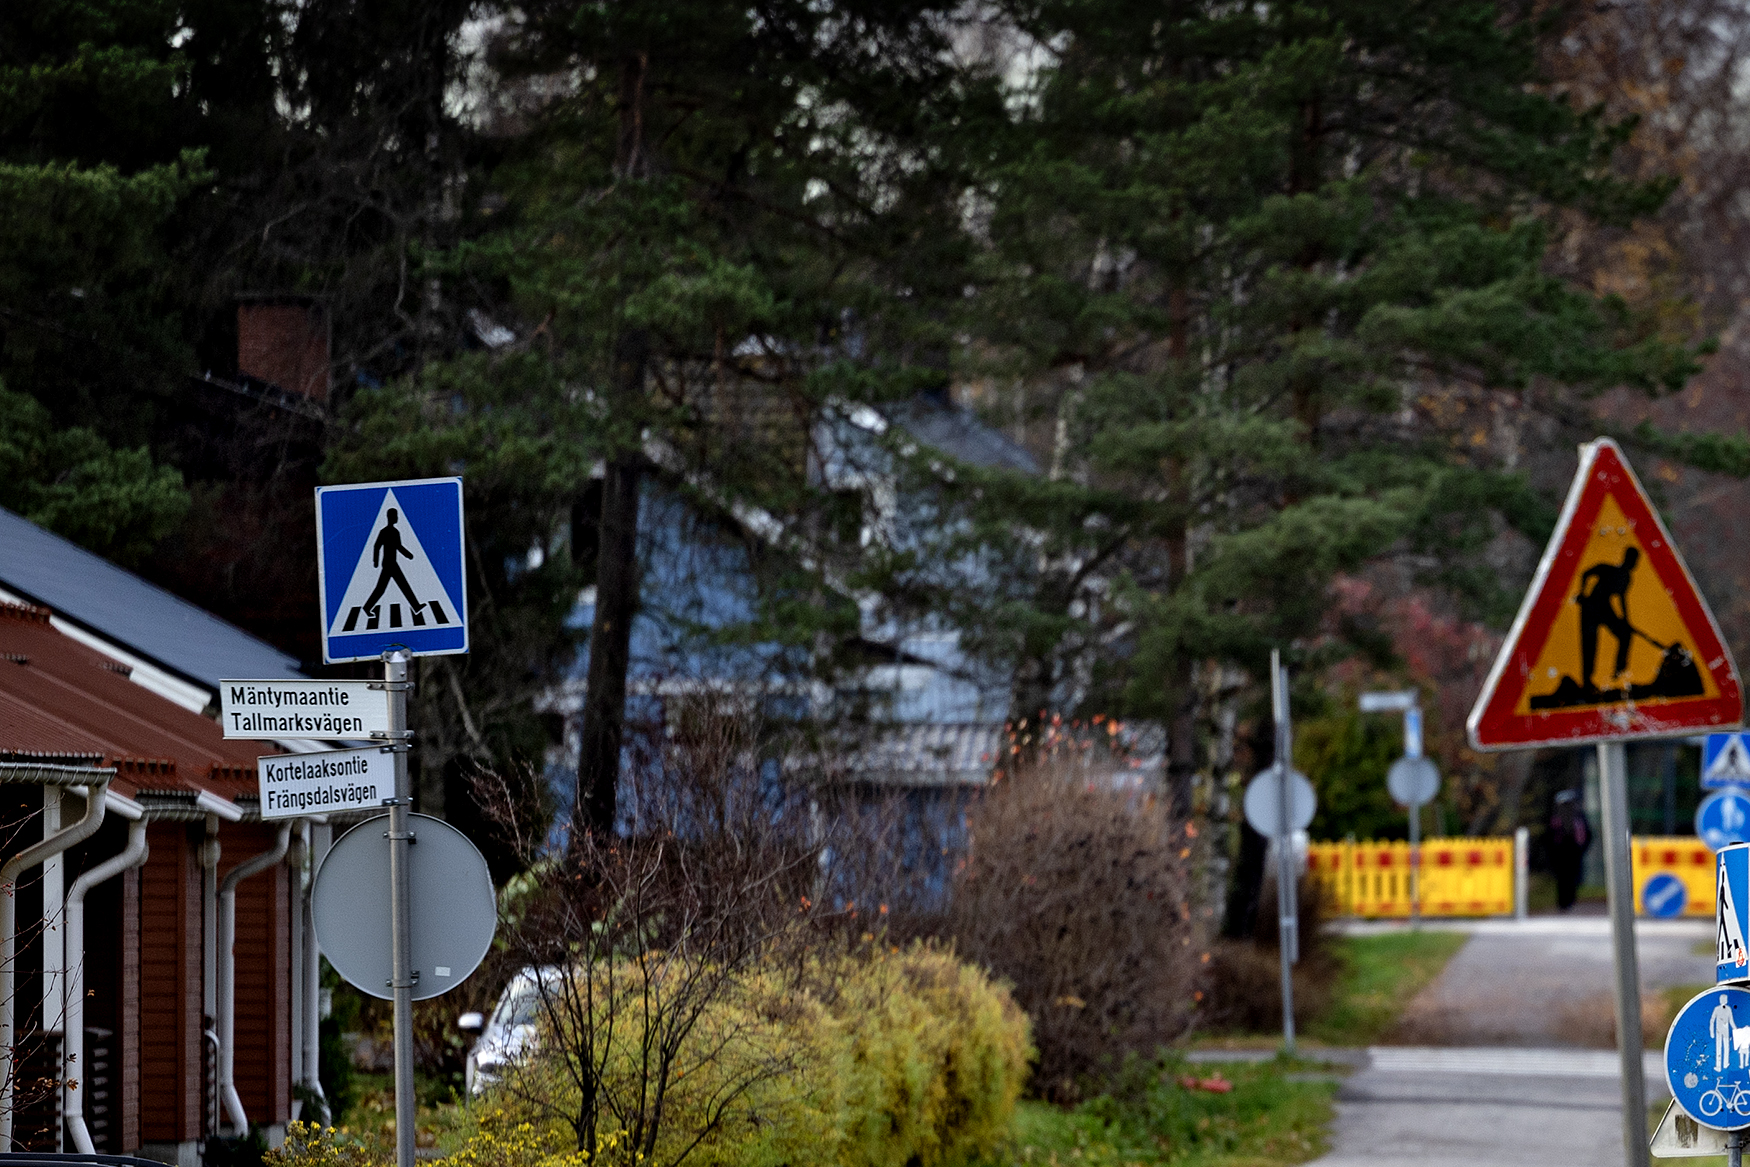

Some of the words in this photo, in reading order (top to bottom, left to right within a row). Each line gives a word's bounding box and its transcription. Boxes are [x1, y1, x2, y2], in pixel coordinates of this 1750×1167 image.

[231, 686, 350, 707] Mäntymaantie
[231, 712, 363, 734] Tallmarksvägen
[266, 755, 368, 783] Kortelaaksontie
[267, 783, 377, 810] Frängsdalsvägen
